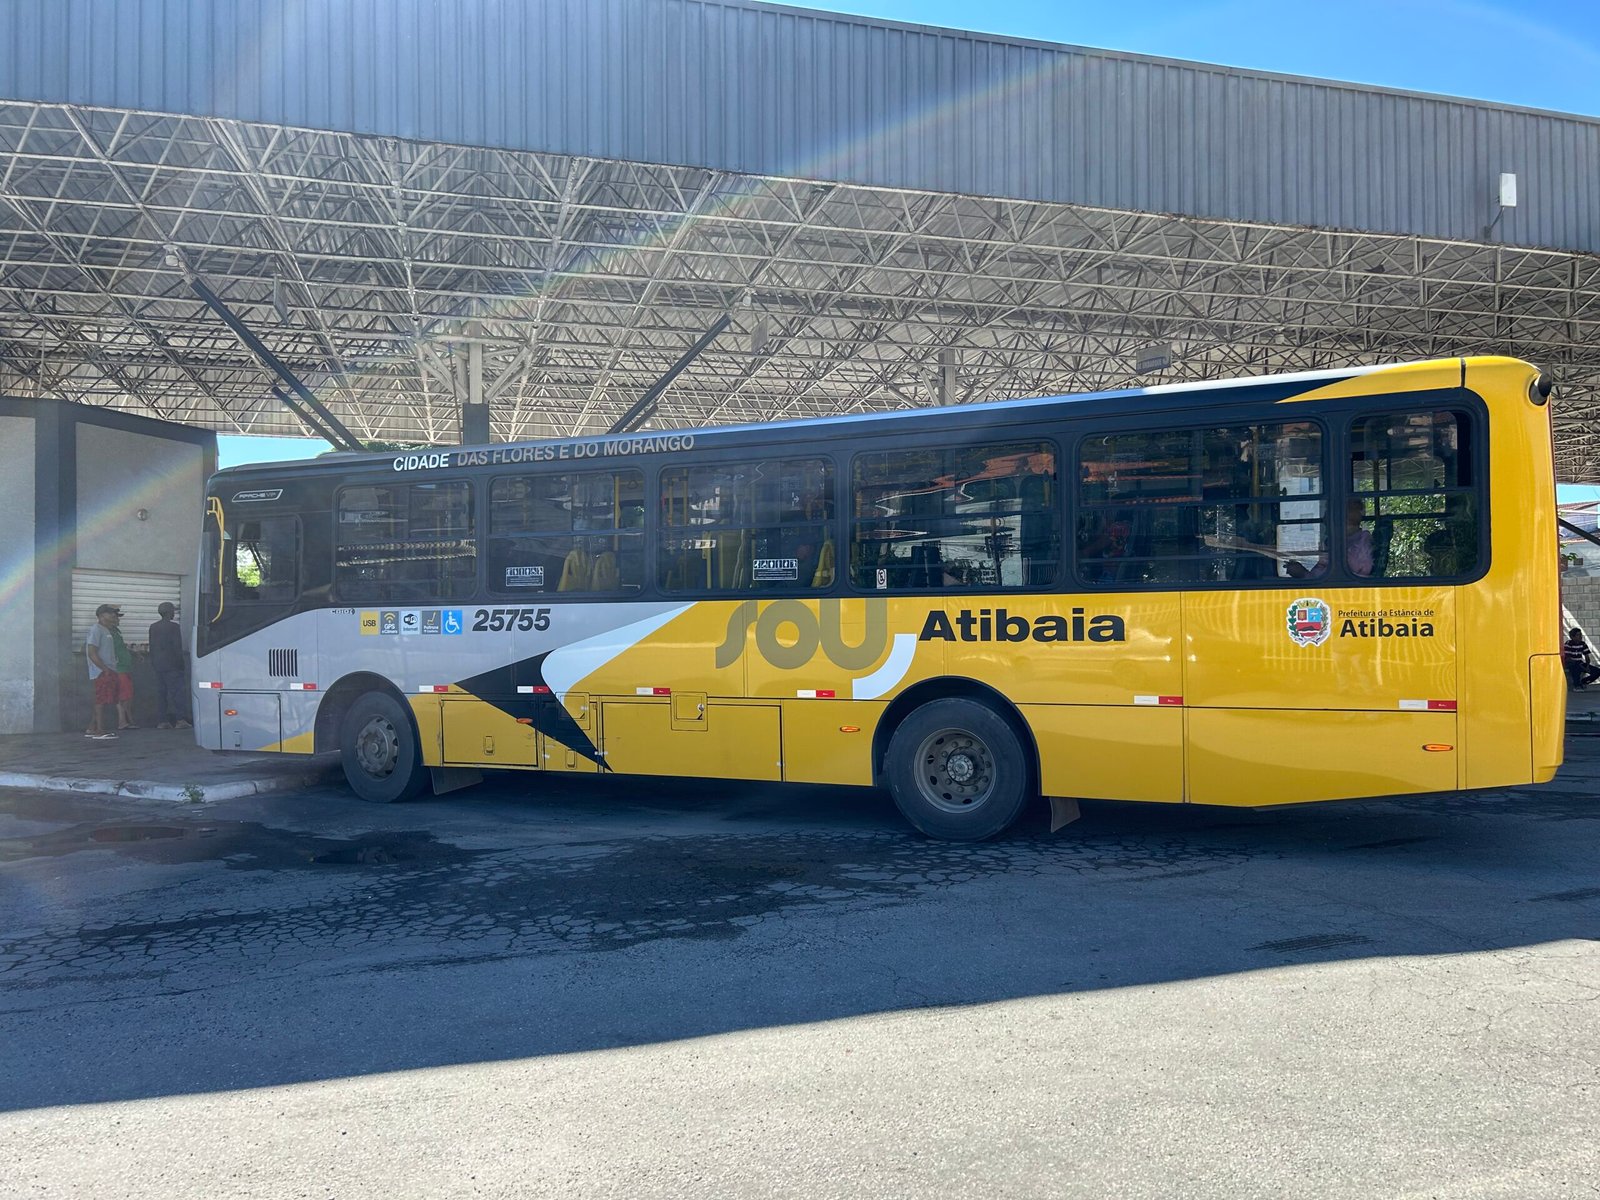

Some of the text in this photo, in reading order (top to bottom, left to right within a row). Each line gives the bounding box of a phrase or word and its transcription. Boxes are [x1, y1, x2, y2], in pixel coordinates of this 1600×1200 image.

[393, 434, 694, 471] CIDADE DAS FLORES E DO MORANGO
[362, 619, 376, 627] USB
[471, 608, 551, 632] 25755
[1338, 608, 1434, 617] Prefeitura da Estância de
[918, 607, 1126, 643] Atibaia
[1340, 618, 1434, 638] Atibaia
